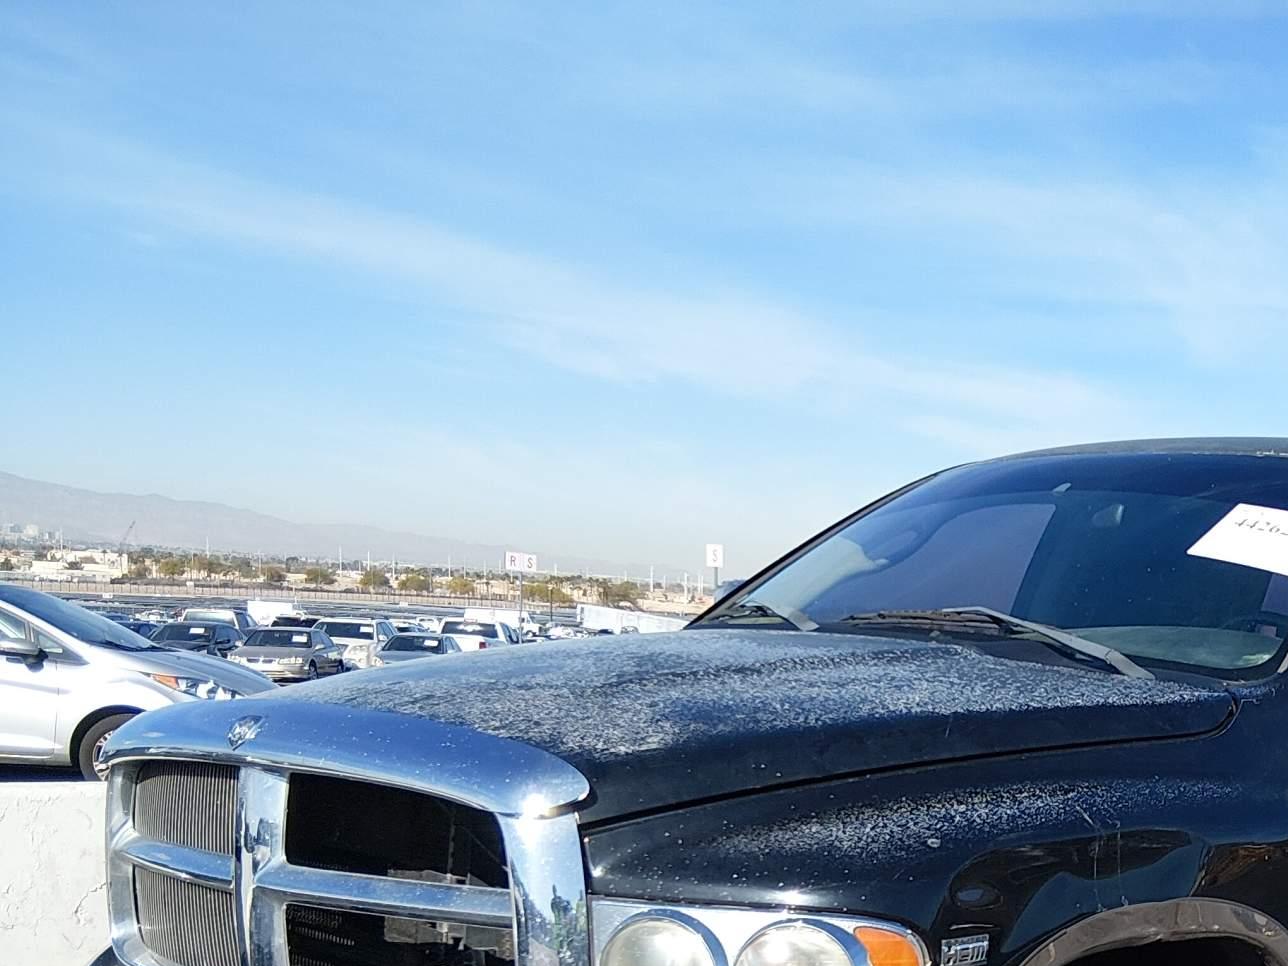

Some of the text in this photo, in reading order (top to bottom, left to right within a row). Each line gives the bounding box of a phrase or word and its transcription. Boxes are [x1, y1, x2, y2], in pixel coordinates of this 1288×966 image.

[510, 555, 517, 567] R
[711, 549, 718, 562] S
[527, 556, 534, 569] S
